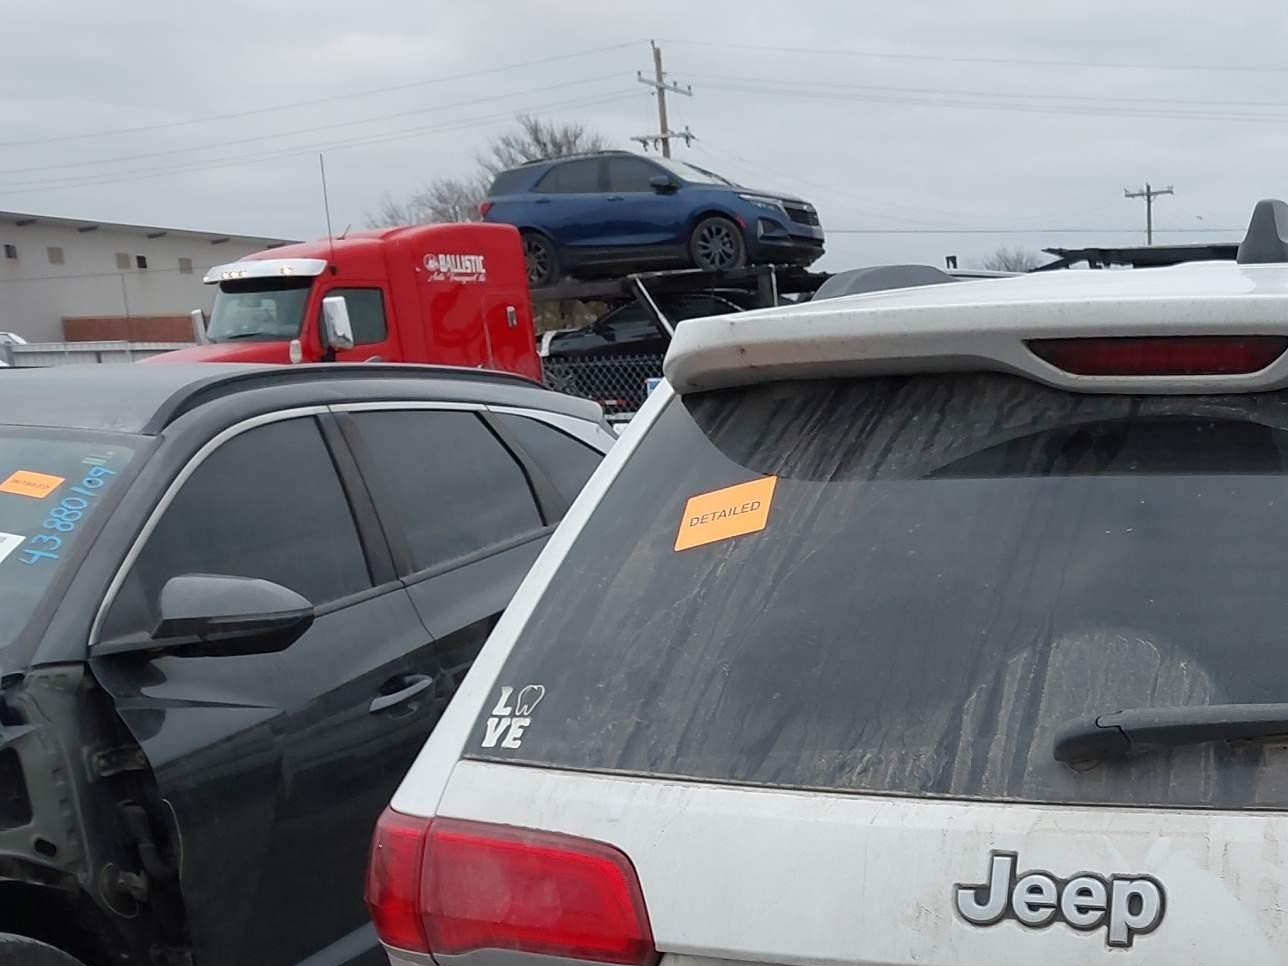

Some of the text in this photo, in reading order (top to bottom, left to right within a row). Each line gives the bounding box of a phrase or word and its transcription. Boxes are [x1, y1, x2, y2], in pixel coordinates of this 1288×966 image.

[438, 253, 486, 273] BALLISTIC
[689, 500, 761, 528] DETAILED
[954, 850, 1166, 947] Jeep
